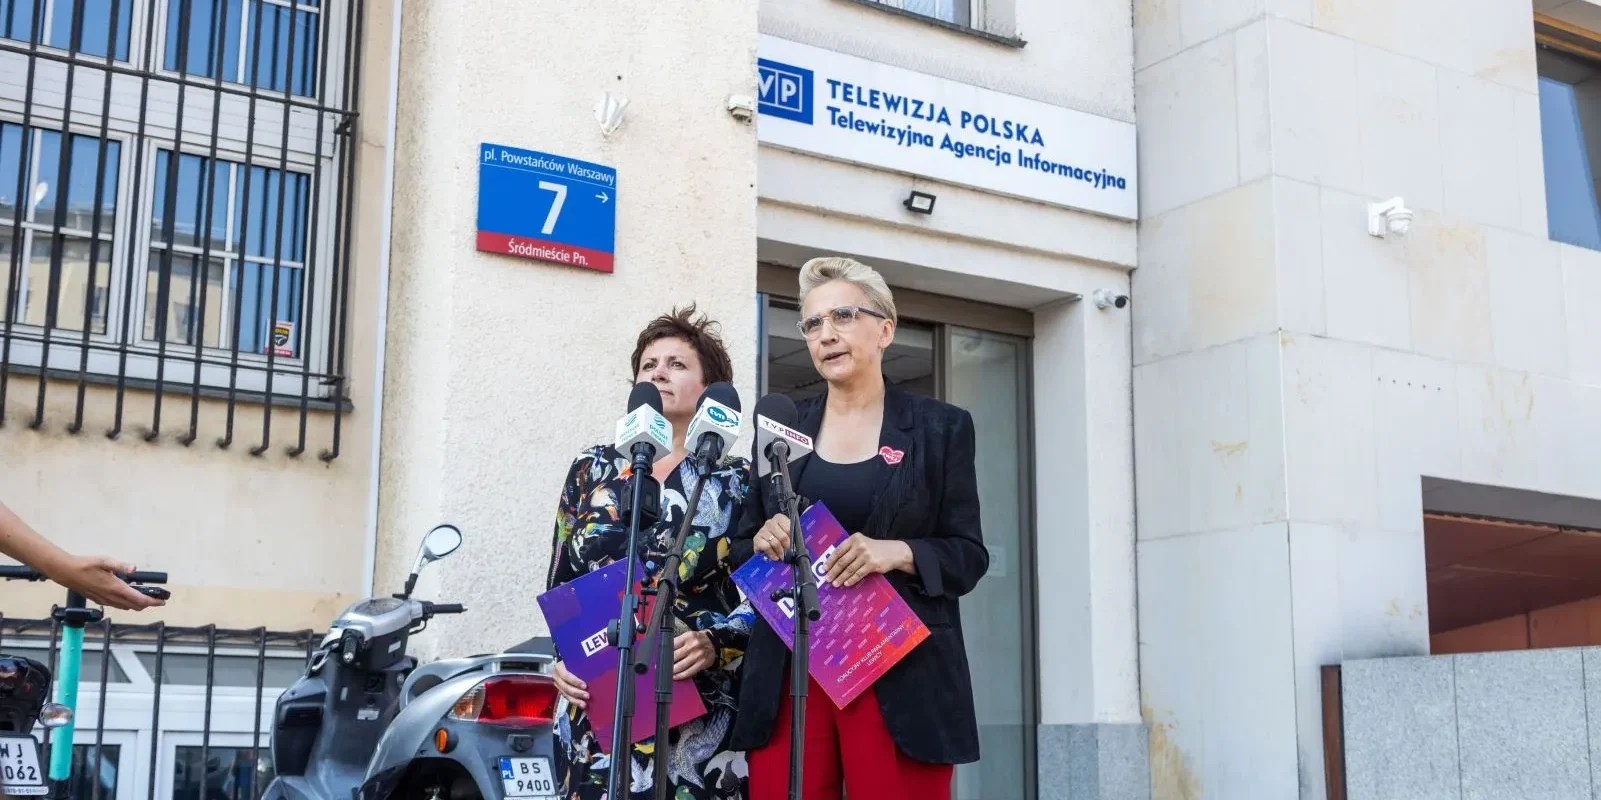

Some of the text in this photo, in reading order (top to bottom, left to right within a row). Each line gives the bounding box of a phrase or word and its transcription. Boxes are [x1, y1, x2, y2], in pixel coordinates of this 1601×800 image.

[758, 72, 797, 103] VP
[827, 78, 1045, 147] TELEWIZJA POLSKA
[827, 106, 1126, 190] Telewizyjna Agencja Informacyjna
[484, 149, 614, 186] pl. Powstańców Warszawy
[538, 180, 567, 235] 7
[508, 238, 588, 265] Śródmieście Pn.
[763, 420, 784, 432] TVP
[585, 631, 608, 653] LEW
[1, 765, 37, 781] 062
[502, 770, 514, 779] PL
[520, 762, 541, 774] BS
[517, 779, 550, 792] 9400
